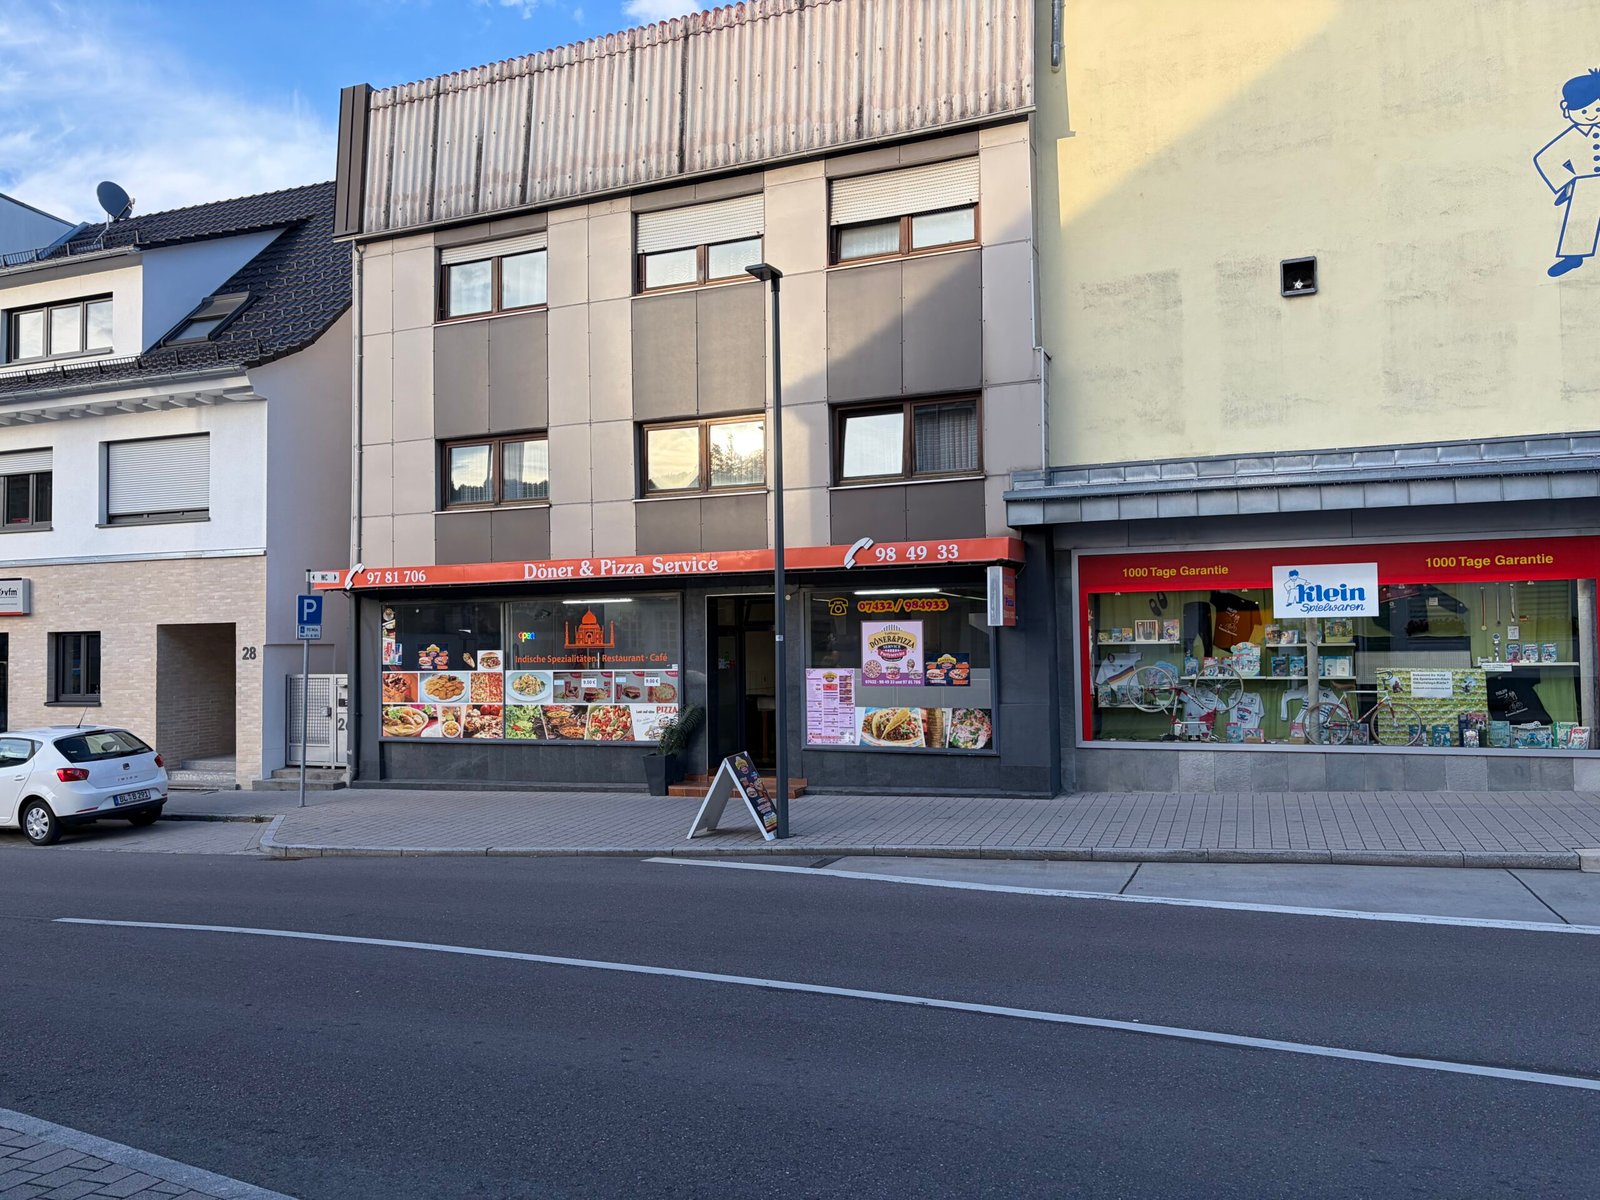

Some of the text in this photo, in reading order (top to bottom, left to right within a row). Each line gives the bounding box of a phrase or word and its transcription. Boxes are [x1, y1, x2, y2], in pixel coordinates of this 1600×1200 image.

[875, 544, 959, 562] 98 49 33
[523, 556, 719, 580] Döner & Pizza Service
[1426, 554, 1554, 568] 1000 Tage Garantie
[367, 570, 426, 585] 97 81 706
[1122, 565, 1229, 579] 1000 Tage Garantie
[303, 599, 317, 621] P
[858, 600, 894, 613] 07432
[903, 598, 949, 612] 984933
[1300, 602, 1365, 614] Spielwaren
[242, 646, 257, 660] 28
[515, 652, 668, 665] Indische Spezialitäten Restaurant Café
[656, 706, 678, 714] PIZZA
[338, 718, 348, 731] 2
